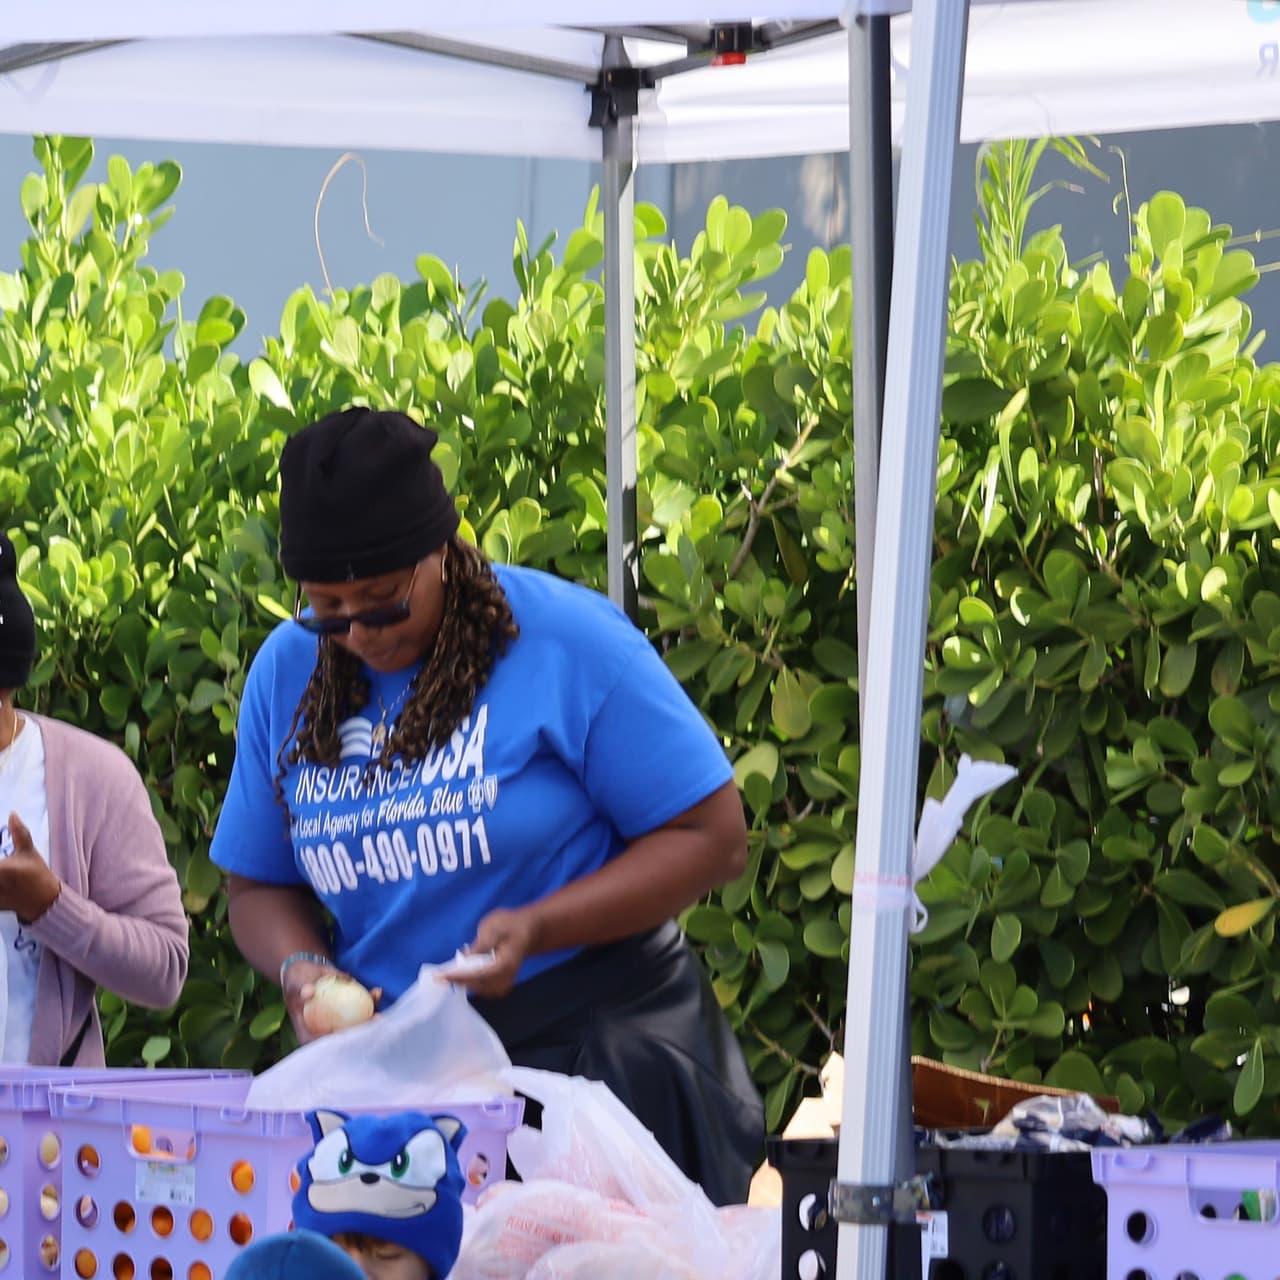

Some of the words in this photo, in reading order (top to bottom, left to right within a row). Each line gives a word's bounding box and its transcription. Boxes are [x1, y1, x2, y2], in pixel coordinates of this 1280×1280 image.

[323, 809, 359, 842] Agency
[361, 804, 375, 829] for
[377, 790, 428, 828] Florida
[429, 783, 464, 817] Blue
